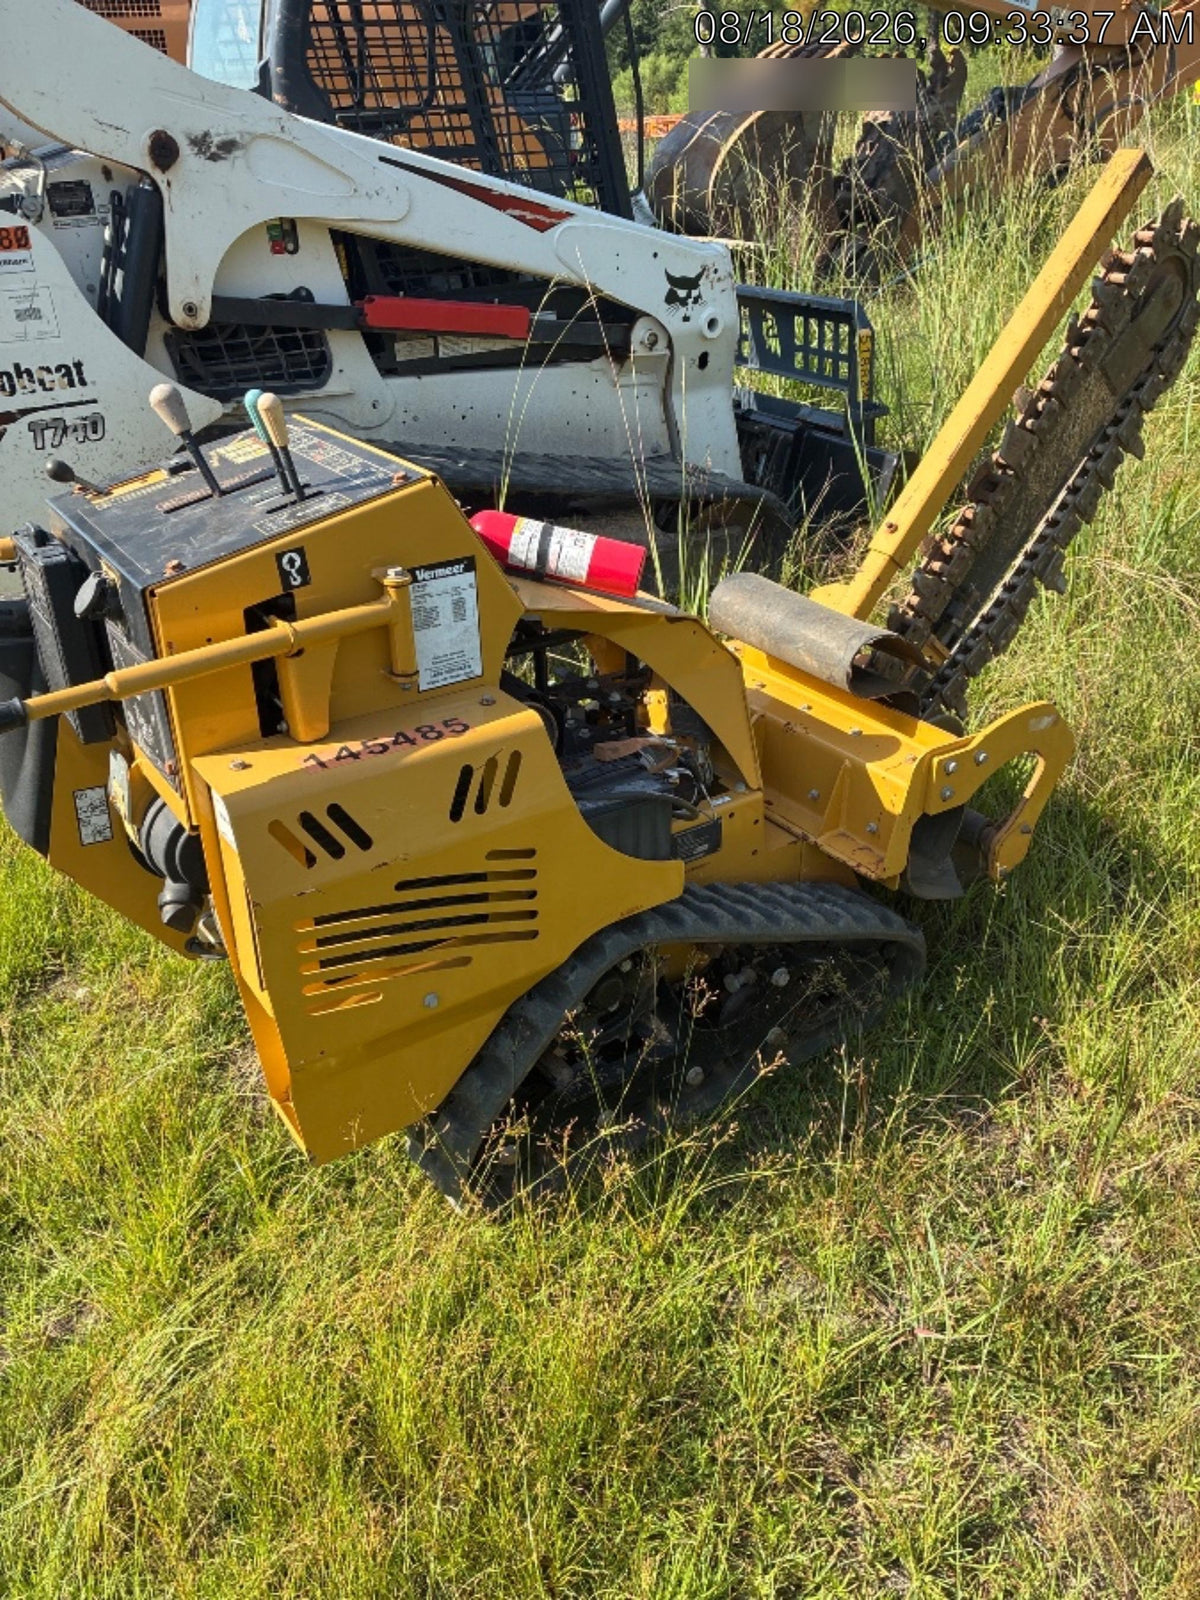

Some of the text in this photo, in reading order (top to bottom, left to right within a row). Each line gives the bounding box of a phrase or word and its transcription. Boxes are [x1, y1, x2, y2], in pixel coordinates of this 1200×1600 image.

[28, 411, 105, 450] T740
[415, 563, 465, 582] Vermeer
[303, 717, 470, 769] 145485
